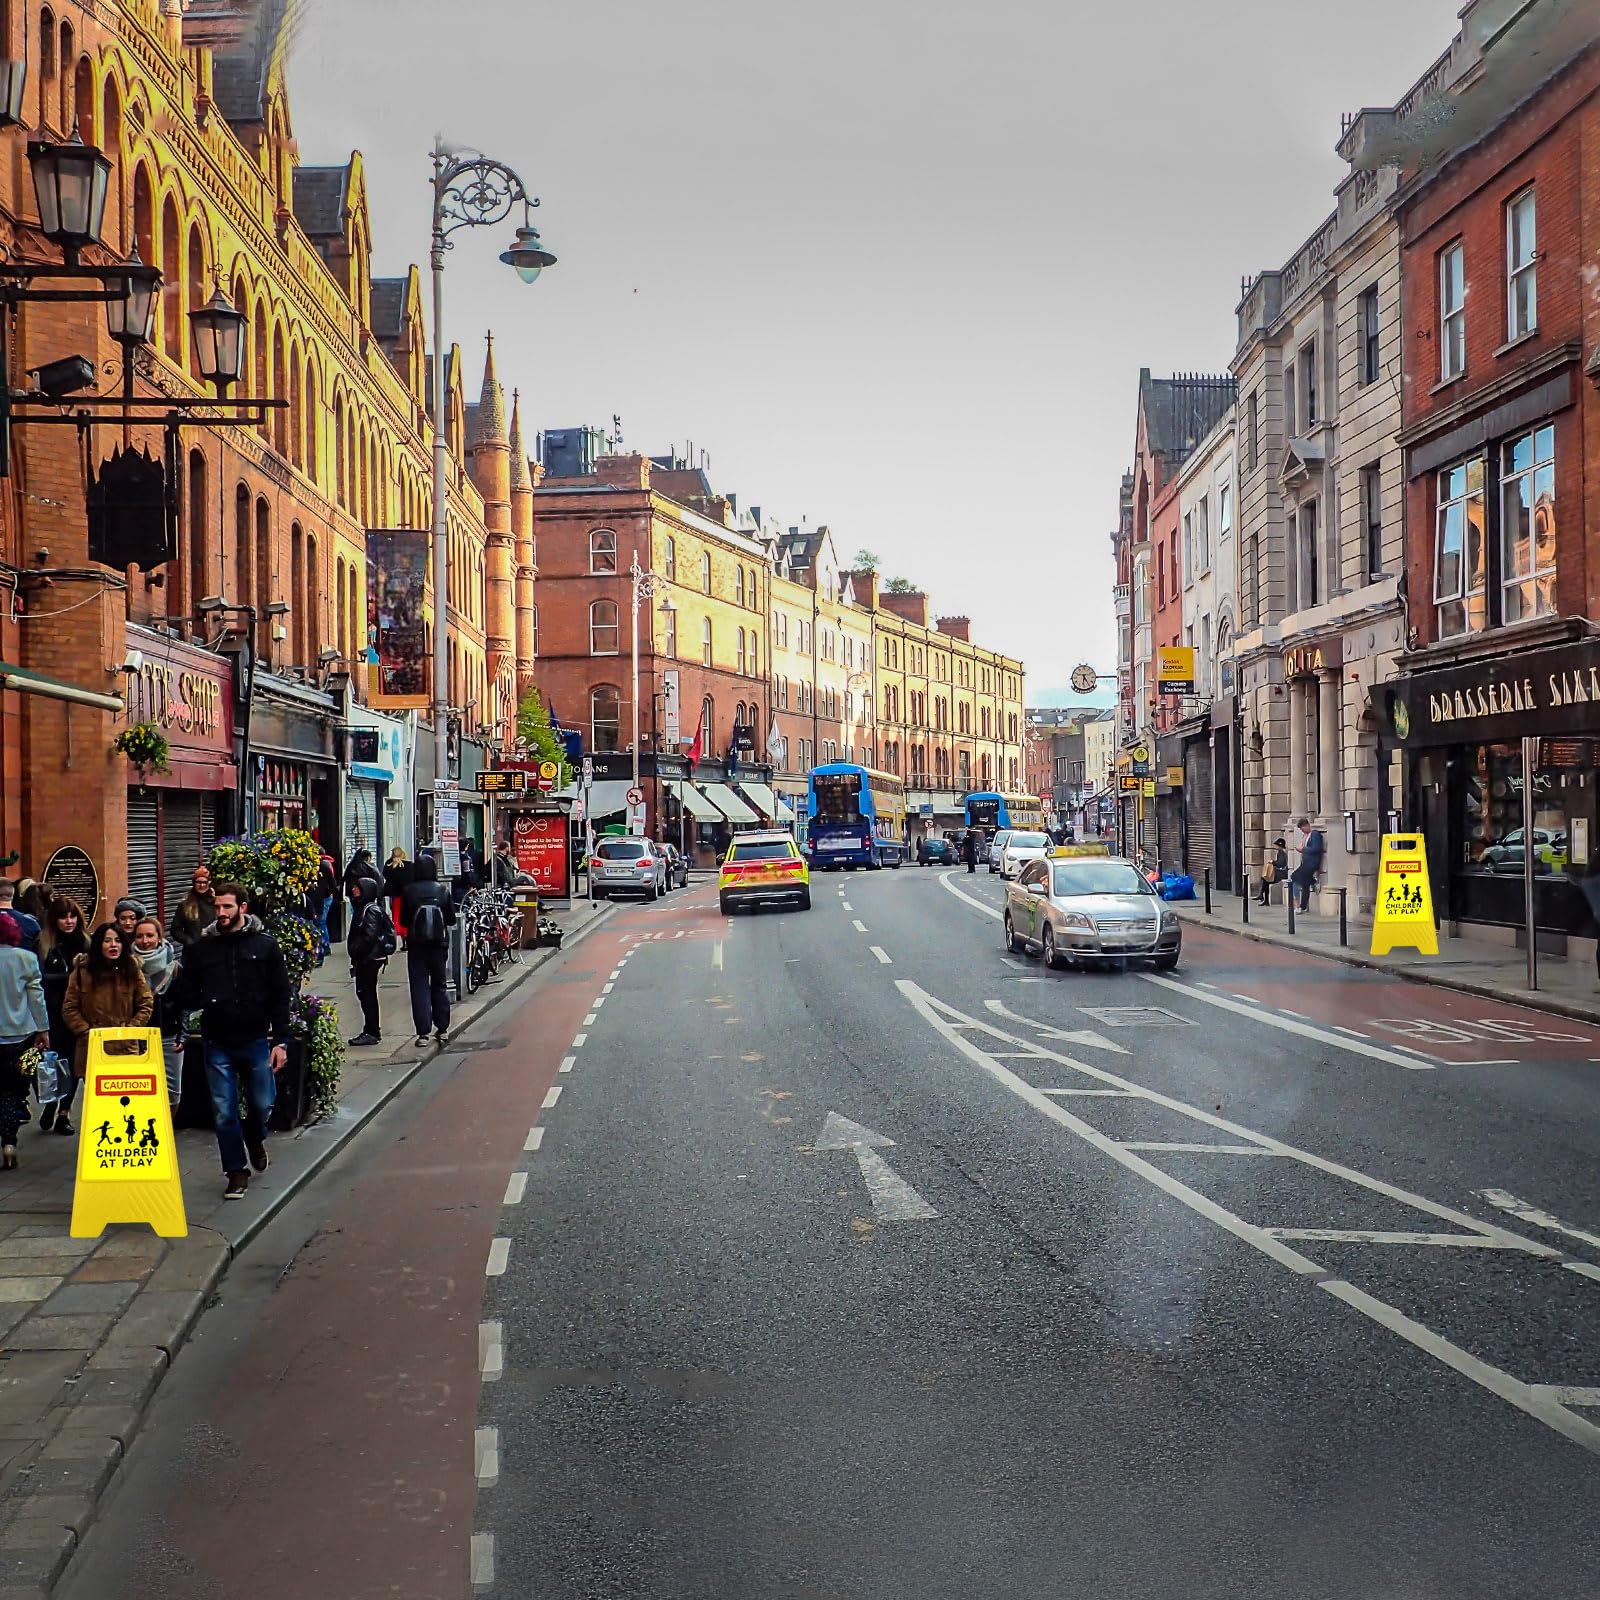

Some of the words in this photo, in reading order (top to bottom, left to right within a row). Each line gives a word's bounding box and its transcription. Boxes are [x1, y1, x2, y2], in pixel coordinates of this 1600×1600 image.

[1430, 678, 1537, 722] BRASSERIE
[1364, 1019, 1592, 1043] BUS
[103, 1081, 150, 1090] CAUTION!
[96, 1147, 157, 1158] CHILDREN
[100, 1159, 116, 1168] AT
[122, 1158, 153, 1168] PLAY
